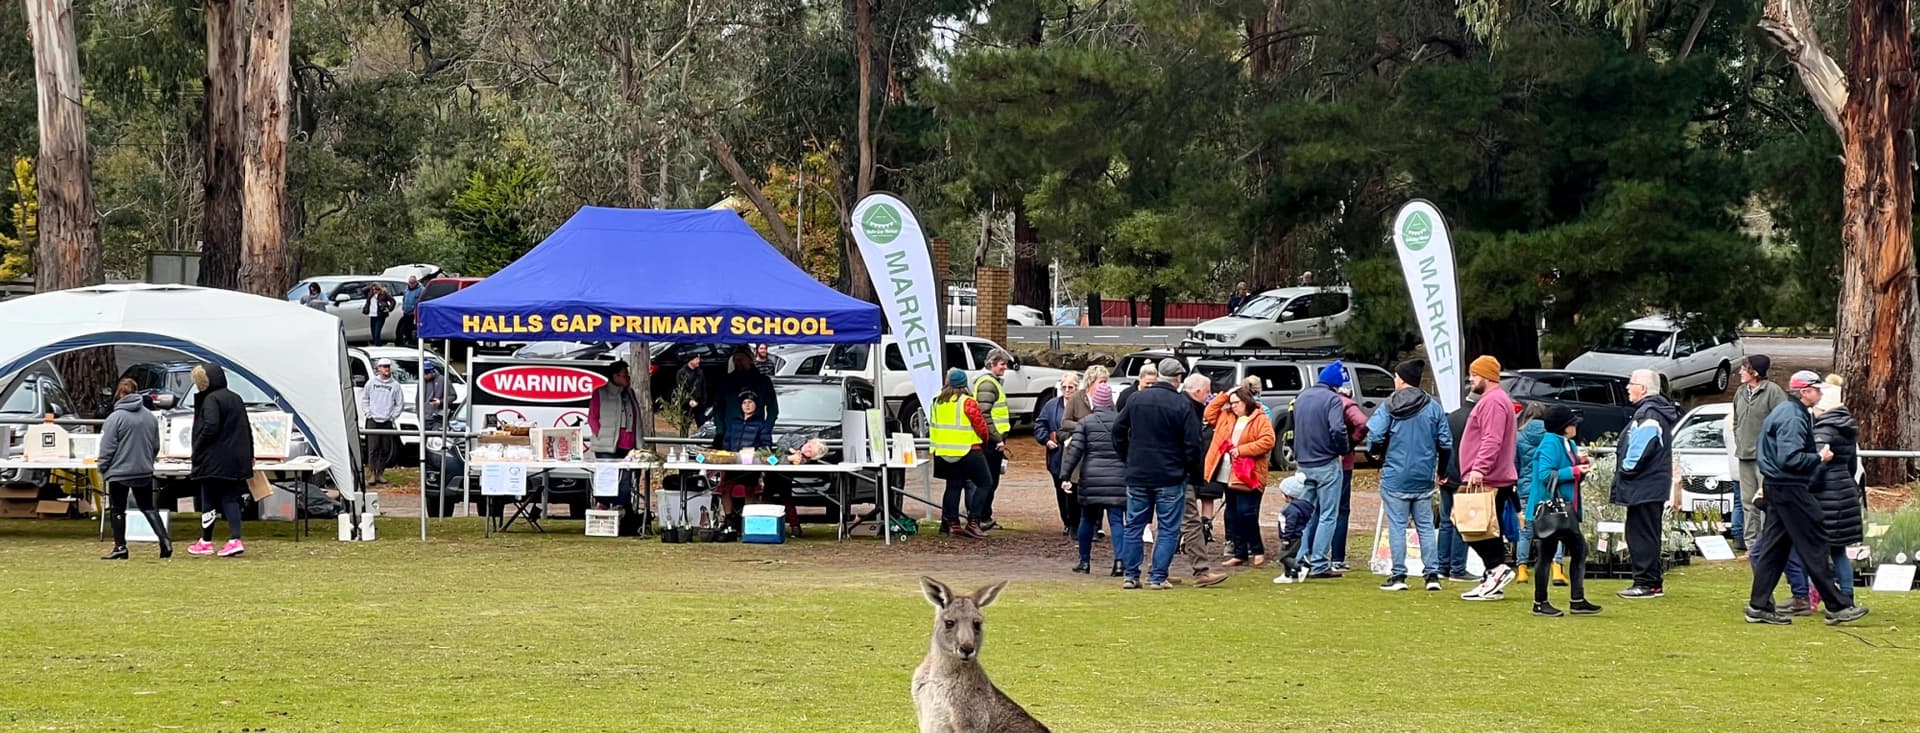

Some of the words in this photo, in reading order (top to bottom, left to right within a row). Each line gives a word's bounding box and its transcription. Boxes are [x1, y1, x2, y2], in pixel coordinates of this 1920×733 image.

[462, 314, 544, 333] HALLS
[551, 314, 602, 333] GAP
[610, 315, 724, 334] PRIMARY
[730, 316, 835, 335] SCHOOL
[884, 250, 935, 371] MARKET
[1419, 256, 1454, 375] MARKET
[493, 374, 593, 393] WARNING
